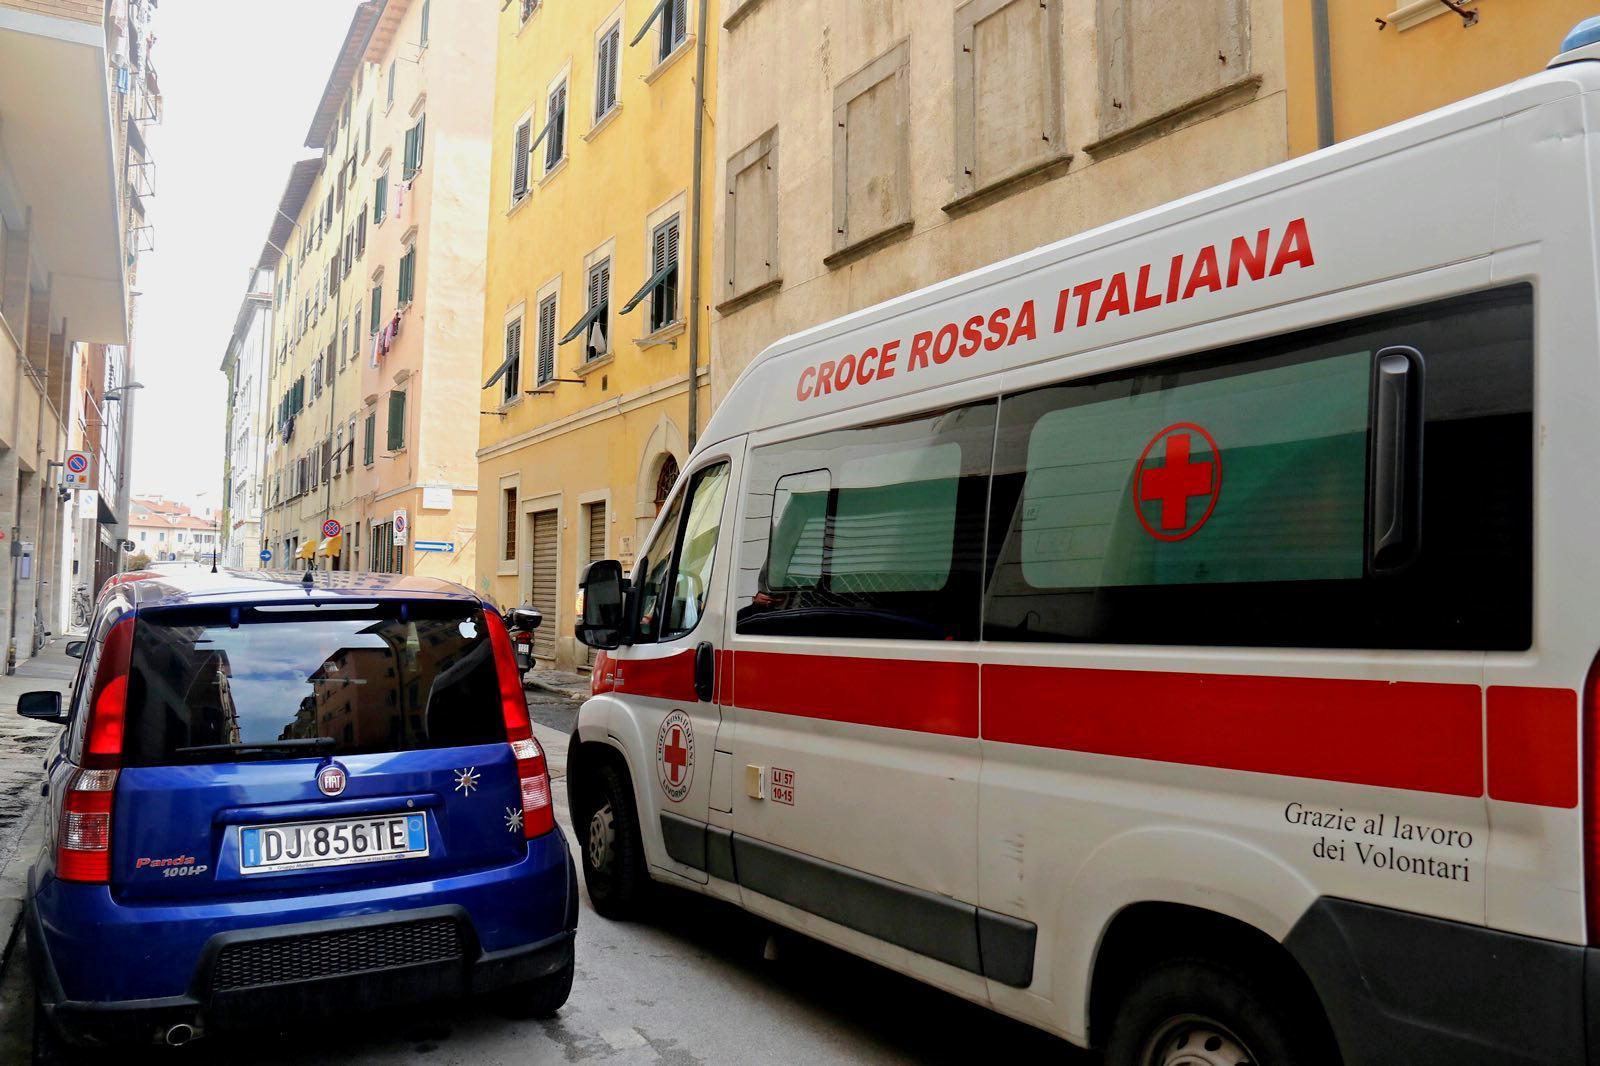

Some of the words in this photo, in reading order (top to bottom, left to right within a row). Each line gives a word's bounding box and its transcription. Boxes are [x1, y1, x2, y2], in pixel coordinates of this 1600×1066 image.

[796, 339, 900, 402] CROCE
[907, 299, 1037, 372] ROSSA
[1053, 217, 1316, 334] ITALIANA
[324, 775, 341, 789] FIAT
[774, 770, 781, 783] LI
[784, 773, 793, 785] 57
[662, 778, 687, 799] LIVORNO
[773, 787, 792, 802] 10-15
[1284, 801, 1356, 832] Grazie
[1363, 814, 1384, 836] al
[1393, 816, 1473, 848] lavoro
[135, 855, 196, 868] Panda
[1312, 837, 1345, 861] dei
[1354, 842, 1470, 882] Volontari
